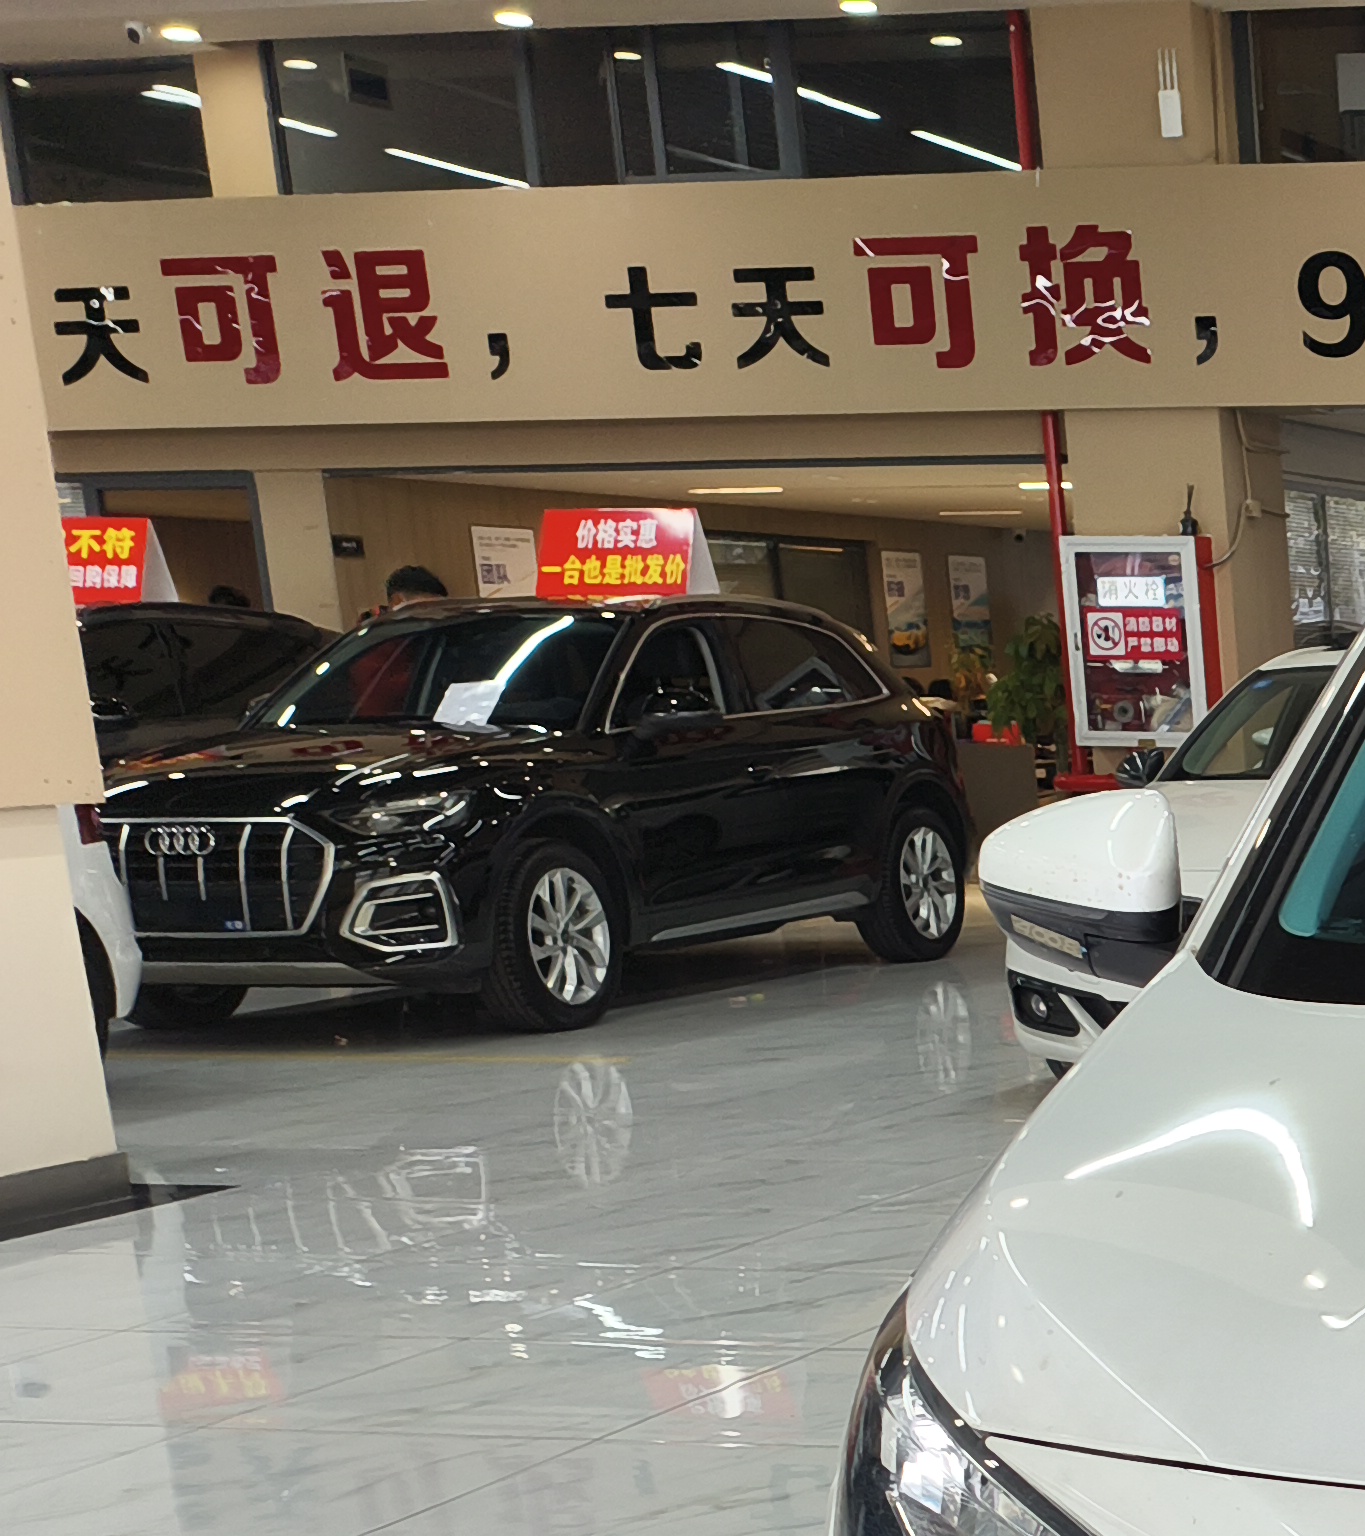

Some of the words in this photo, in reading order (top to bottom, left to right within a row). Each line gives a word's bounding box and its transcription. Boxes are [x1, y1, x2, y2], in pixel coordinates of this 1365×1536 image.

[576, 518, 658, 549] 价格实惠
[541, 554, 686, 586] 一台也是批发价
[1101, 580, 1159, 601] 消火栓
